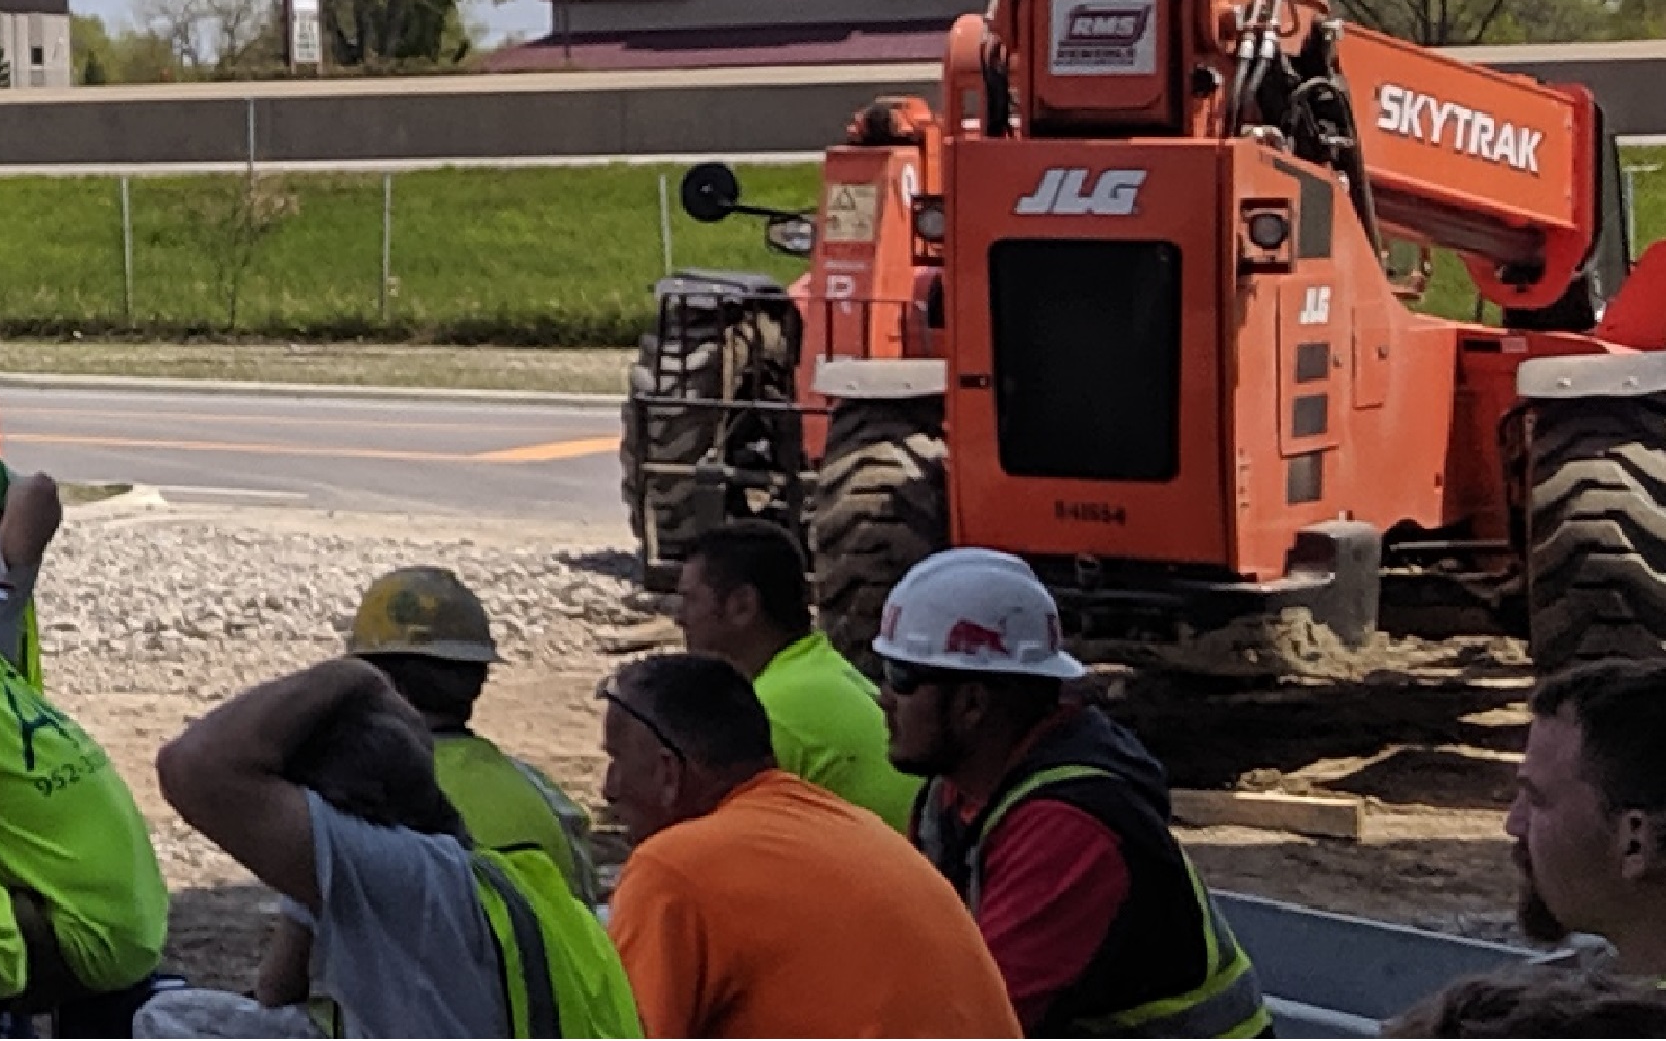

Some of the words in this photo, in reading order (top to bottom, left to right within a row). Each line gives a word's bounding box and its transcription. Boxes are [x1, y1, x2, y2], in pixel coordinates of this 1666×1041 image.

[1073, 17, 1135, 36] RMS
[1377, 84, 1542, 173] SKYTRAK
[1015, 169, 1147, 215] JLG
[1300, 286, 1330, 324] JLG
